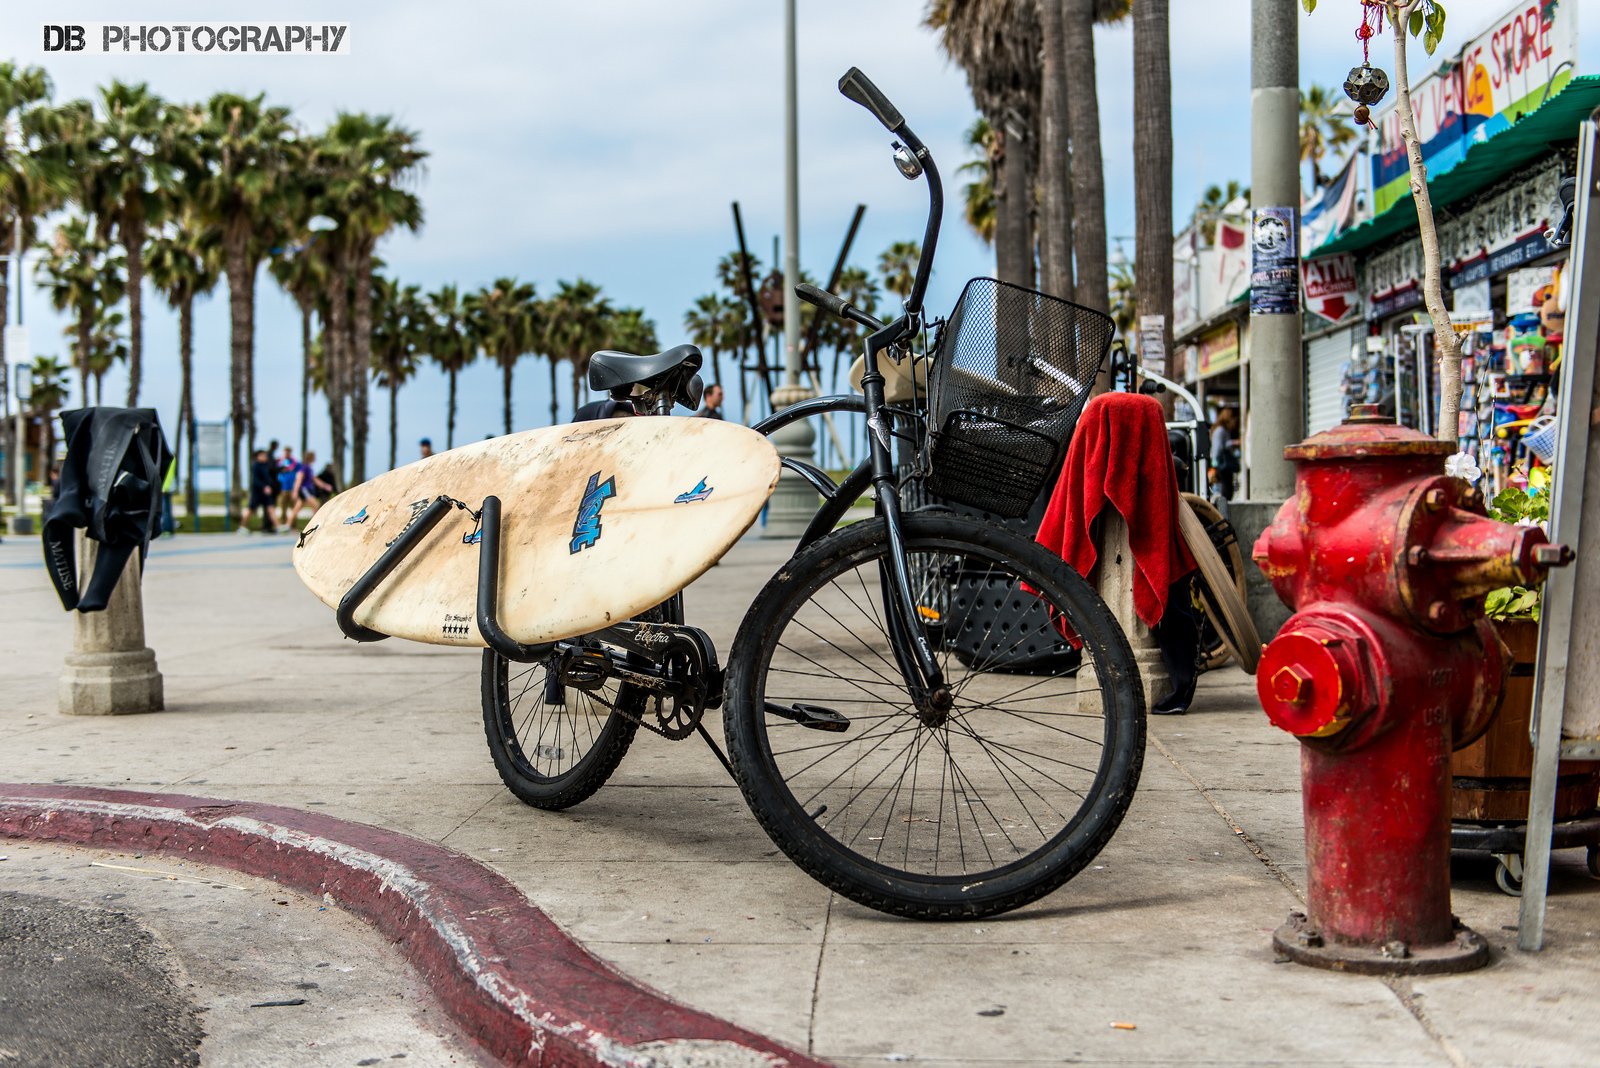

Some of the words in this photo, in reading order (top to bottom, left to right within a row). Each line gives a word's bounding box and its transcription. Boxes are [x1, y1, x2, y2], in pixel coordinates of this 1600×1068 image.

[1491, 0, 1552, 90] STORE
[1306, 256, 1357, 286] ATM
[1307, 280, 1354, 296] MACHINE
[634, 630, 670, 644] Electra
